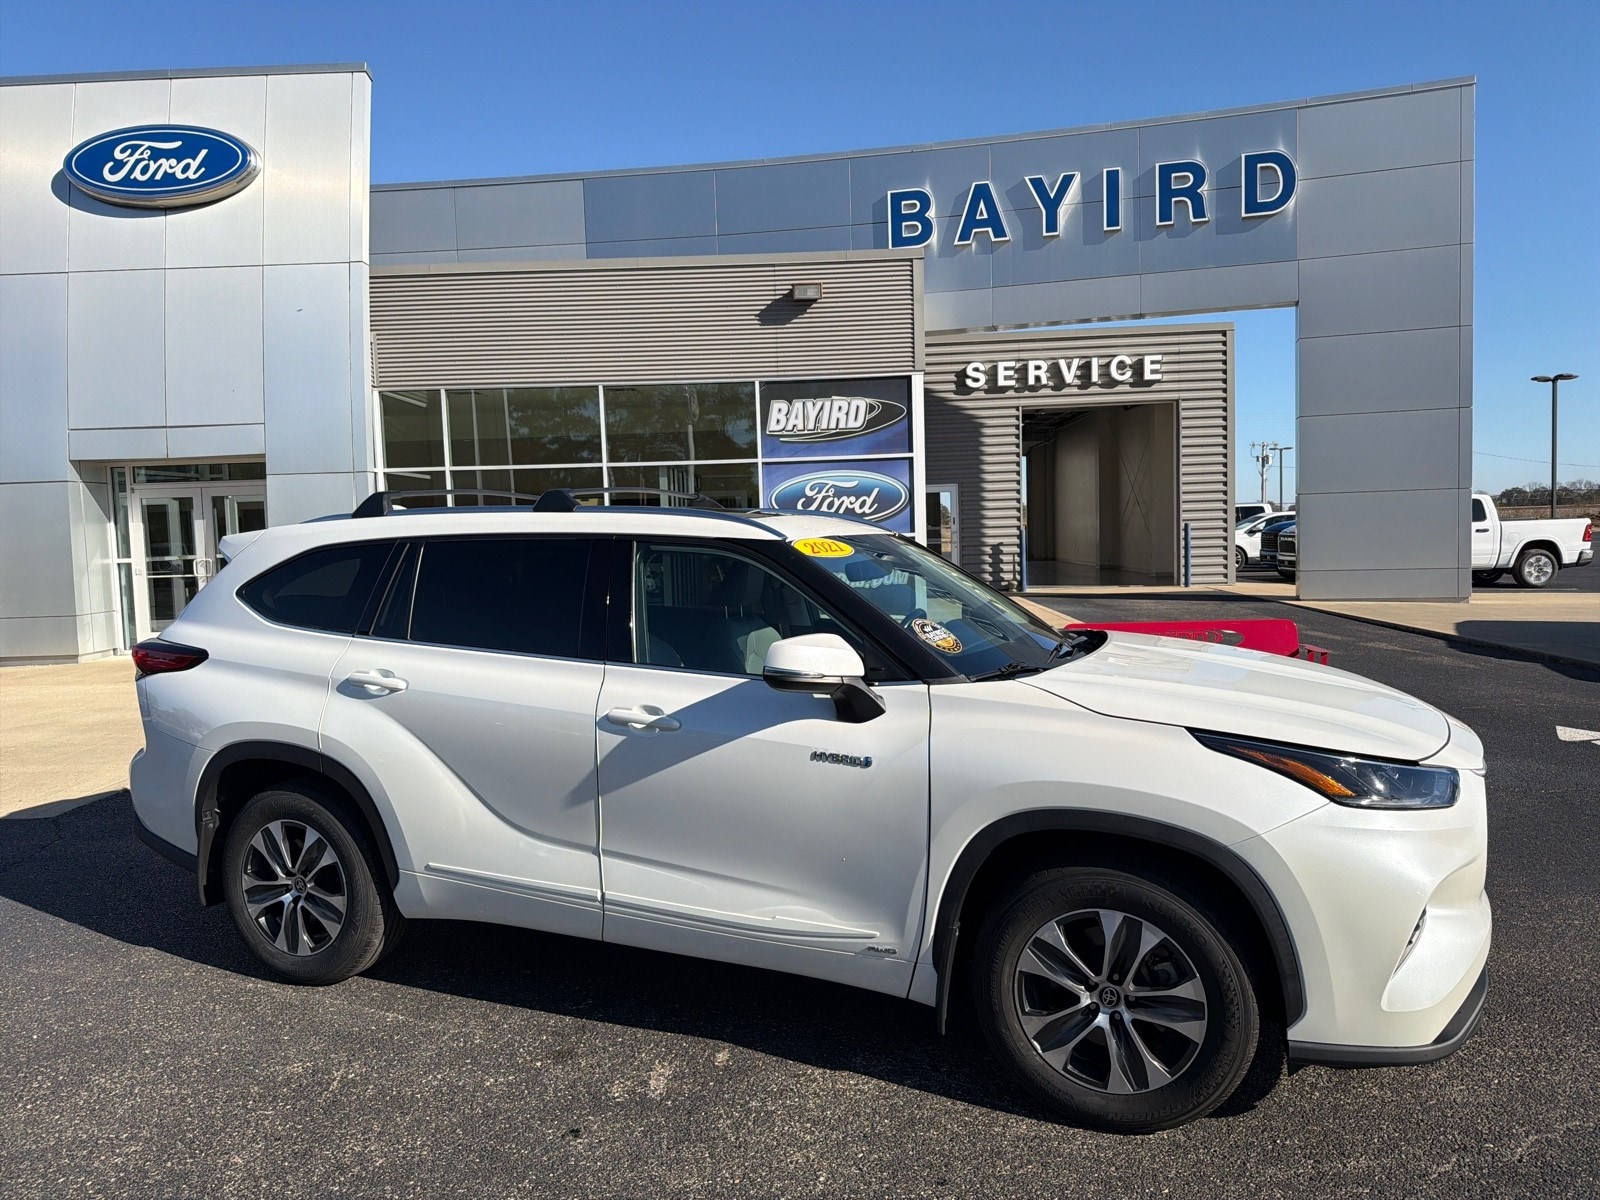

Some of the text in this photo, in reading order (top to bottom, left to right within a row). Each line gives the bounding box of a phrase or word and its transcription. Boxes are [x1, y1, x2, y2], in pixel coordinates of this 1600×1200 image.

[103, 140, 209, 183] Ford
[887, 150, 1300, 250] BAYIRD
[964, 354, 1166, 388] SERVICE
[766, 398, 868, 433] BAYIRD
[797, 479, 881, 515] Ford
[804, 540, 847, 555] 2021
